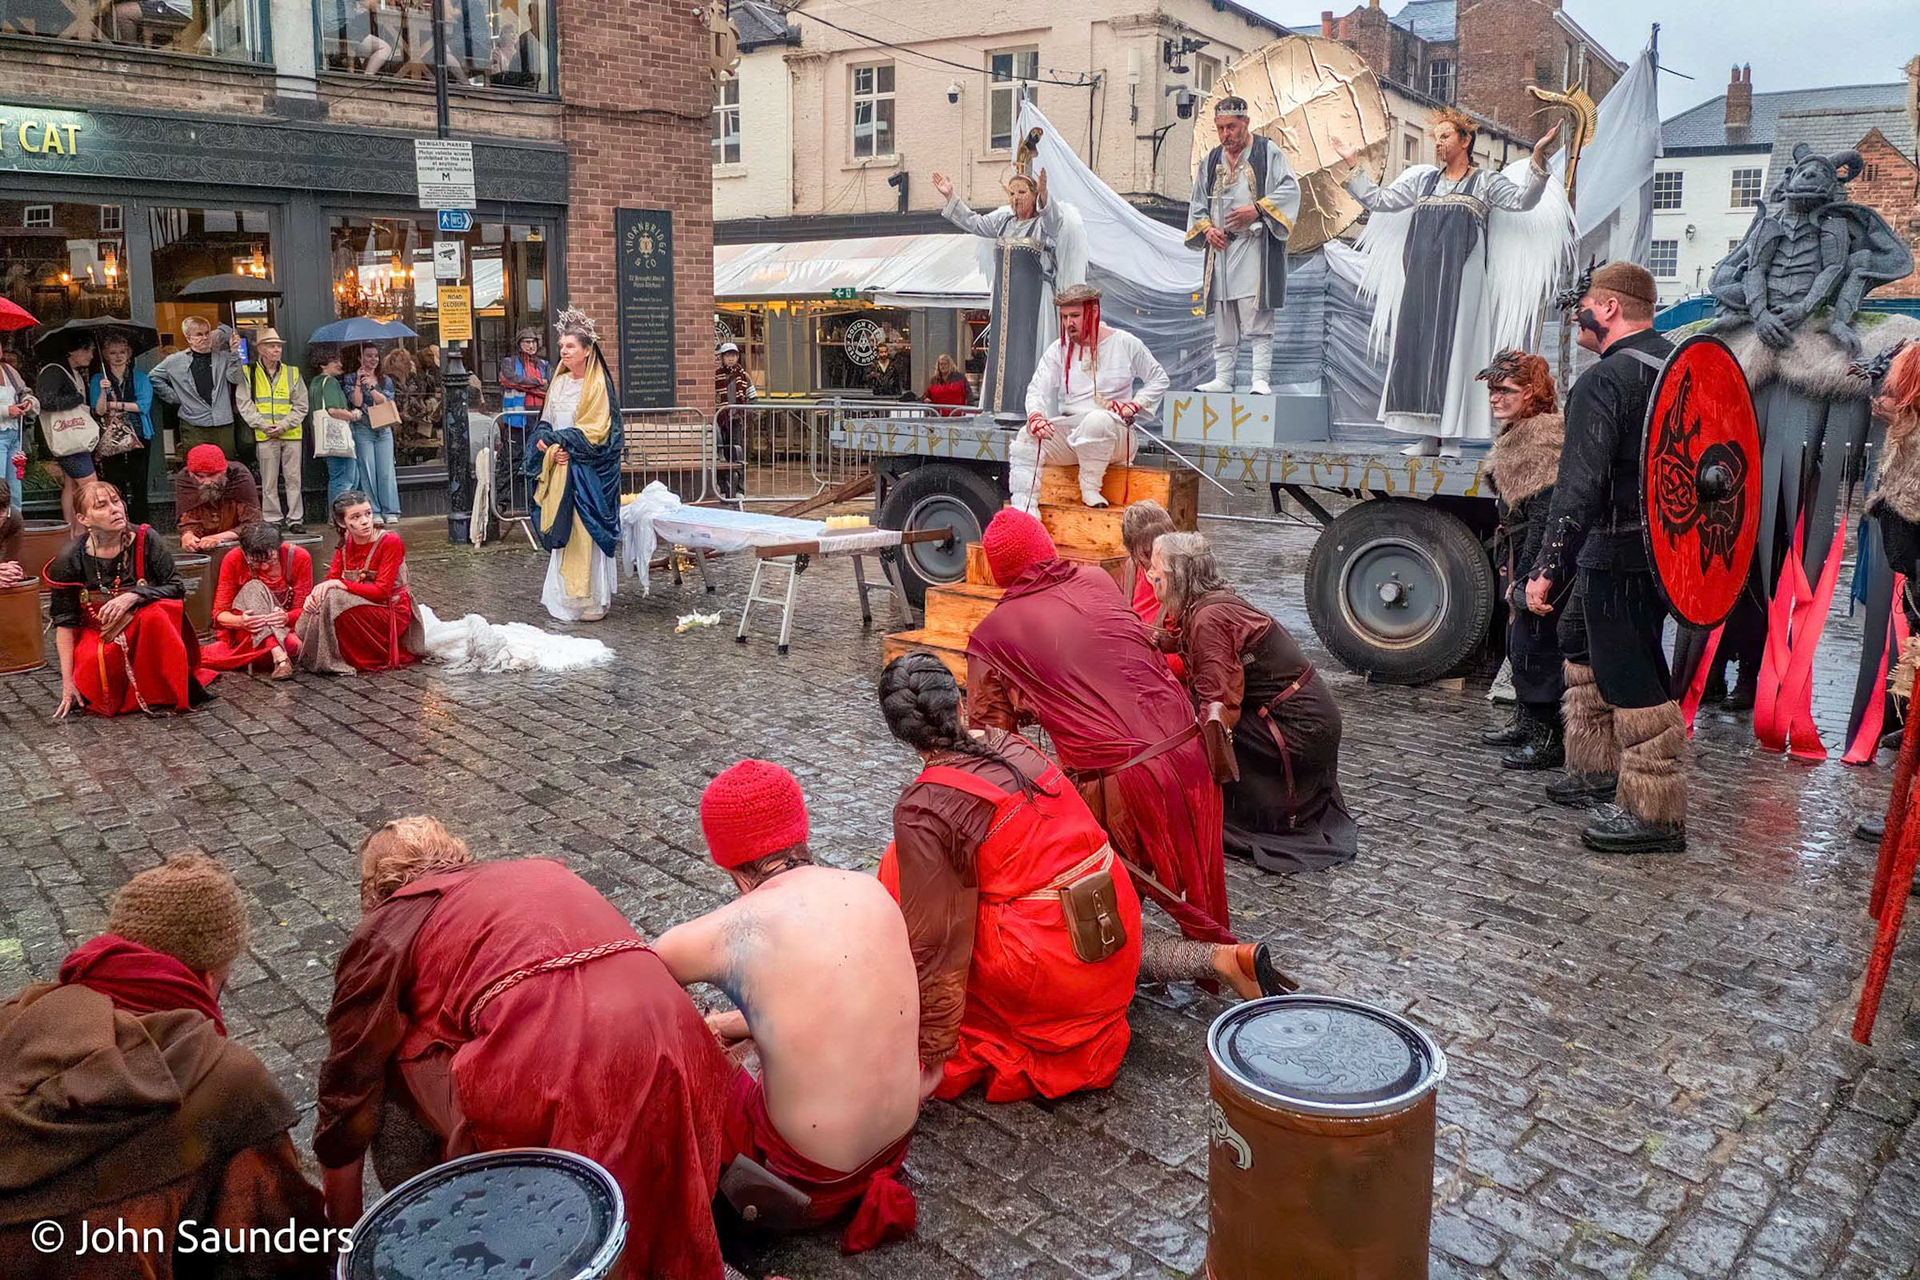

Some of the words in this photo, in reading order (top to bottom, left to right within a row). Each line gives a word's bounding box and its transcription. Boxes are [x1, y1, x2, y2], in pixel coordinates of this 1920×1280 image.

[18, 121, 82, 155] CAT
[442, 172, 451, 181] M
[625, 221, 667, 255] THORNBRIDGE
[634, 258, 642, 266] &
[645, 259, 657, 268] CO
